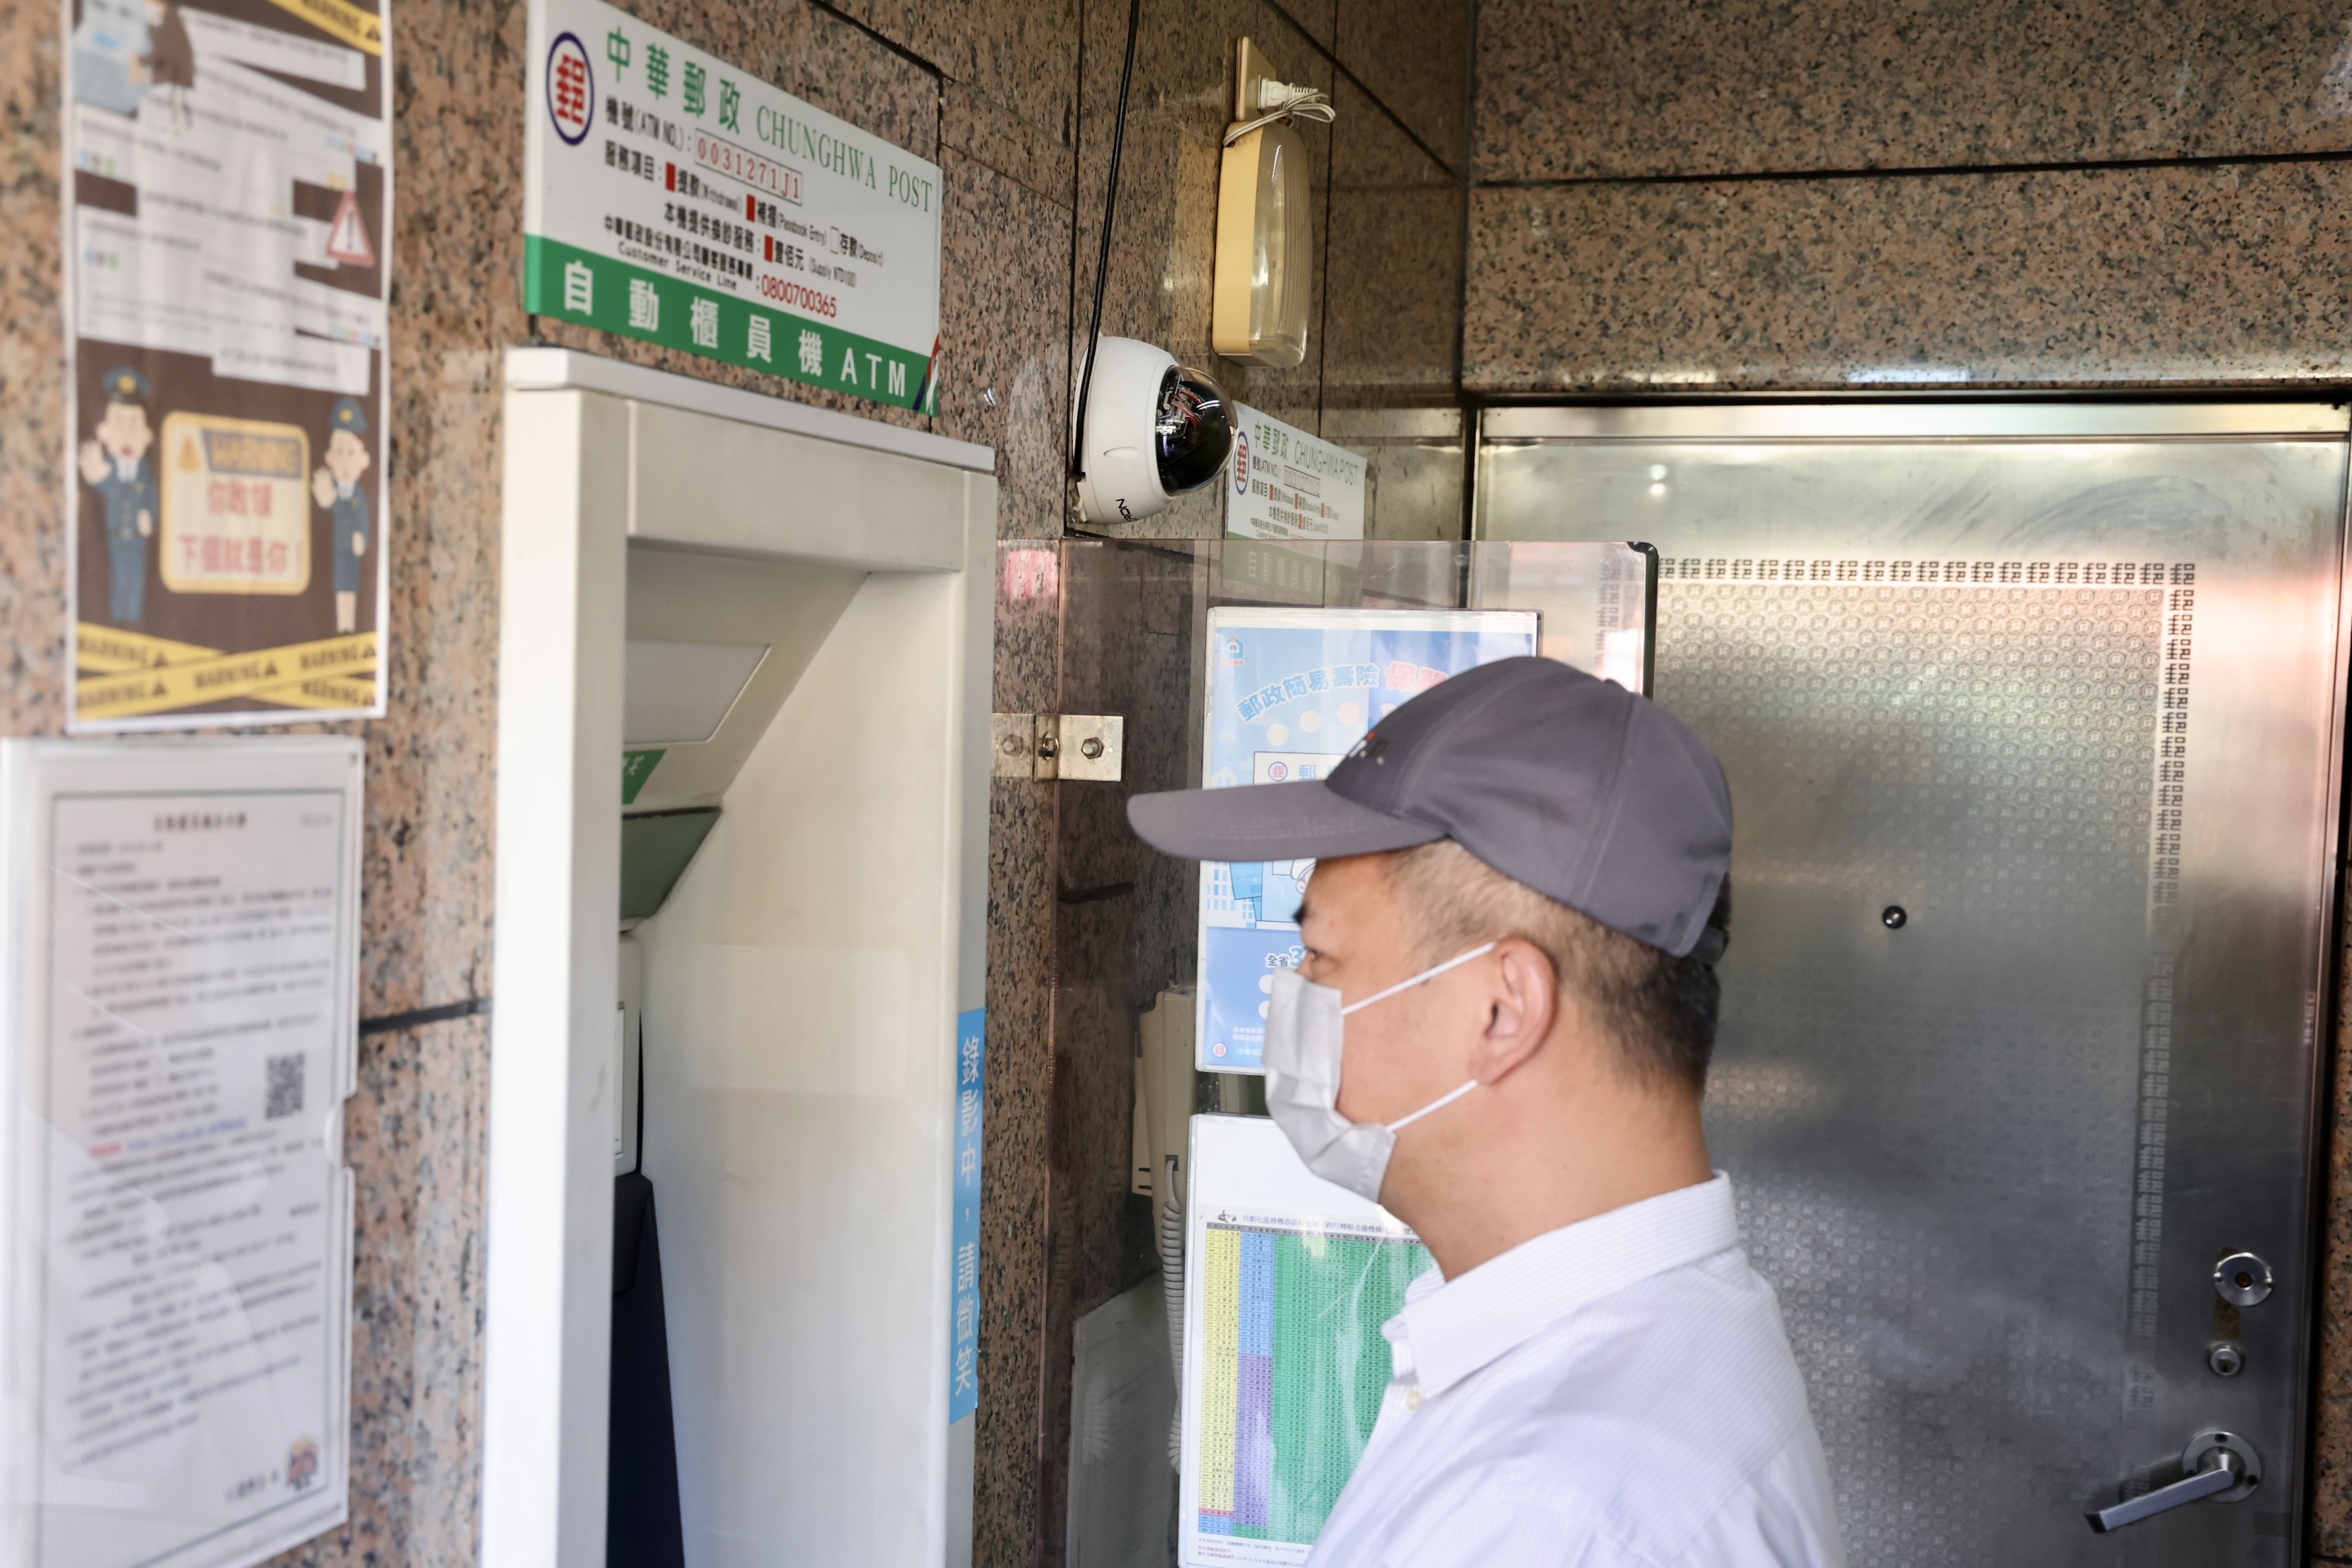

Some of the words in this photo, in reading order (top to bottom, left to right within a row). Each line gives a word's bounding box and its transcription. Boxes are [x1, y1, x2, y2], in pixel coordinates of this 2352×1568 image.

[607, 26, 741, 135] 中華郵政
[756, 104, 877, 190] CHUNGHWA
[889, 164, 933, 213] POST
[564, 261, 822, 378] 自動櫃員機
[840, 347, 906, 397] ATM
[618, 240, 669, 269] Customer
[675, 259, 711, 283] Service
[717, 273, 737, 291] Line
